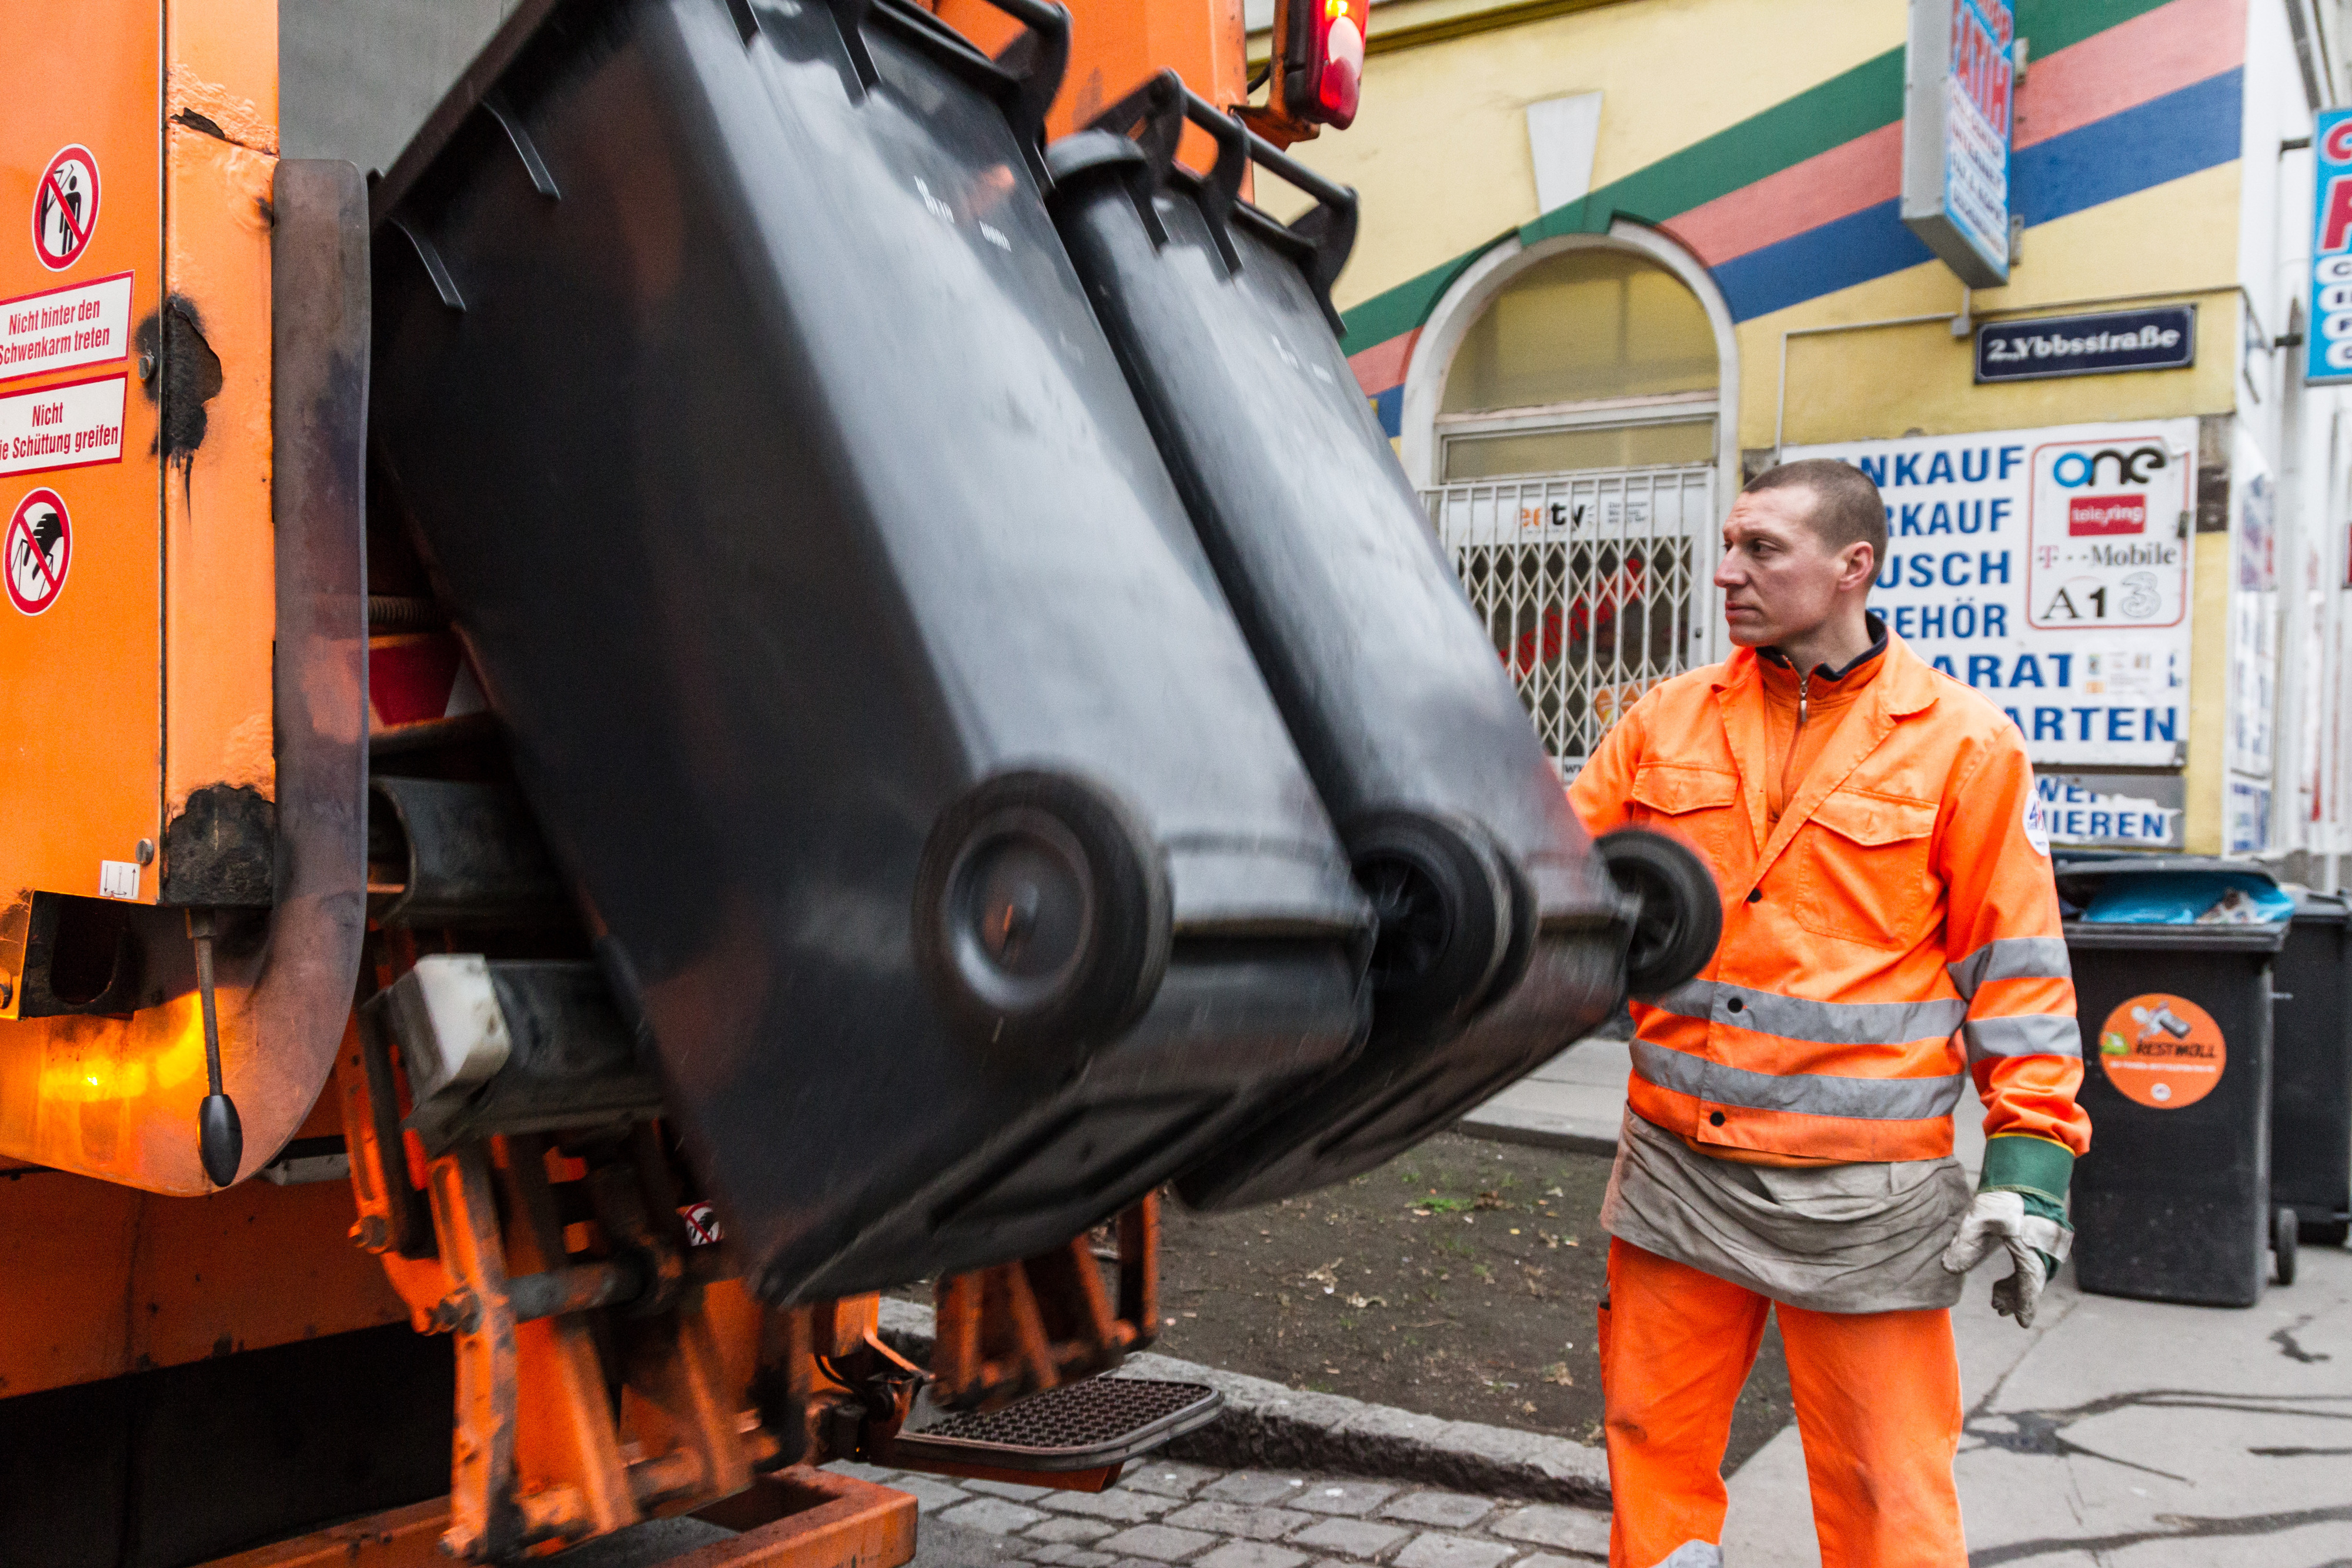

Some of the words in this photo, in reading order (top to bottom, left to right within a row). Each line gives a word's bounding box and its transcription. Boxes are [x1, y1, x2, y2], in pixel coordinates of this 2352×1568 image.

[8, 310, 39, 336] Nicht
[41, 305, 76, 329] hinter
[78, 299, 101, 323] den
[74, 327, 110, 352] treten
[32, 402, 64, 427] Nicht
[12, 433, 71, 459] Schüttung
[75, 424, 119, 453] greifen
[1836, 444, 2025, 488] NKAUF
[2053, 447, 2167, 488] one
[2042, 808, 2165, 838] IEREN
